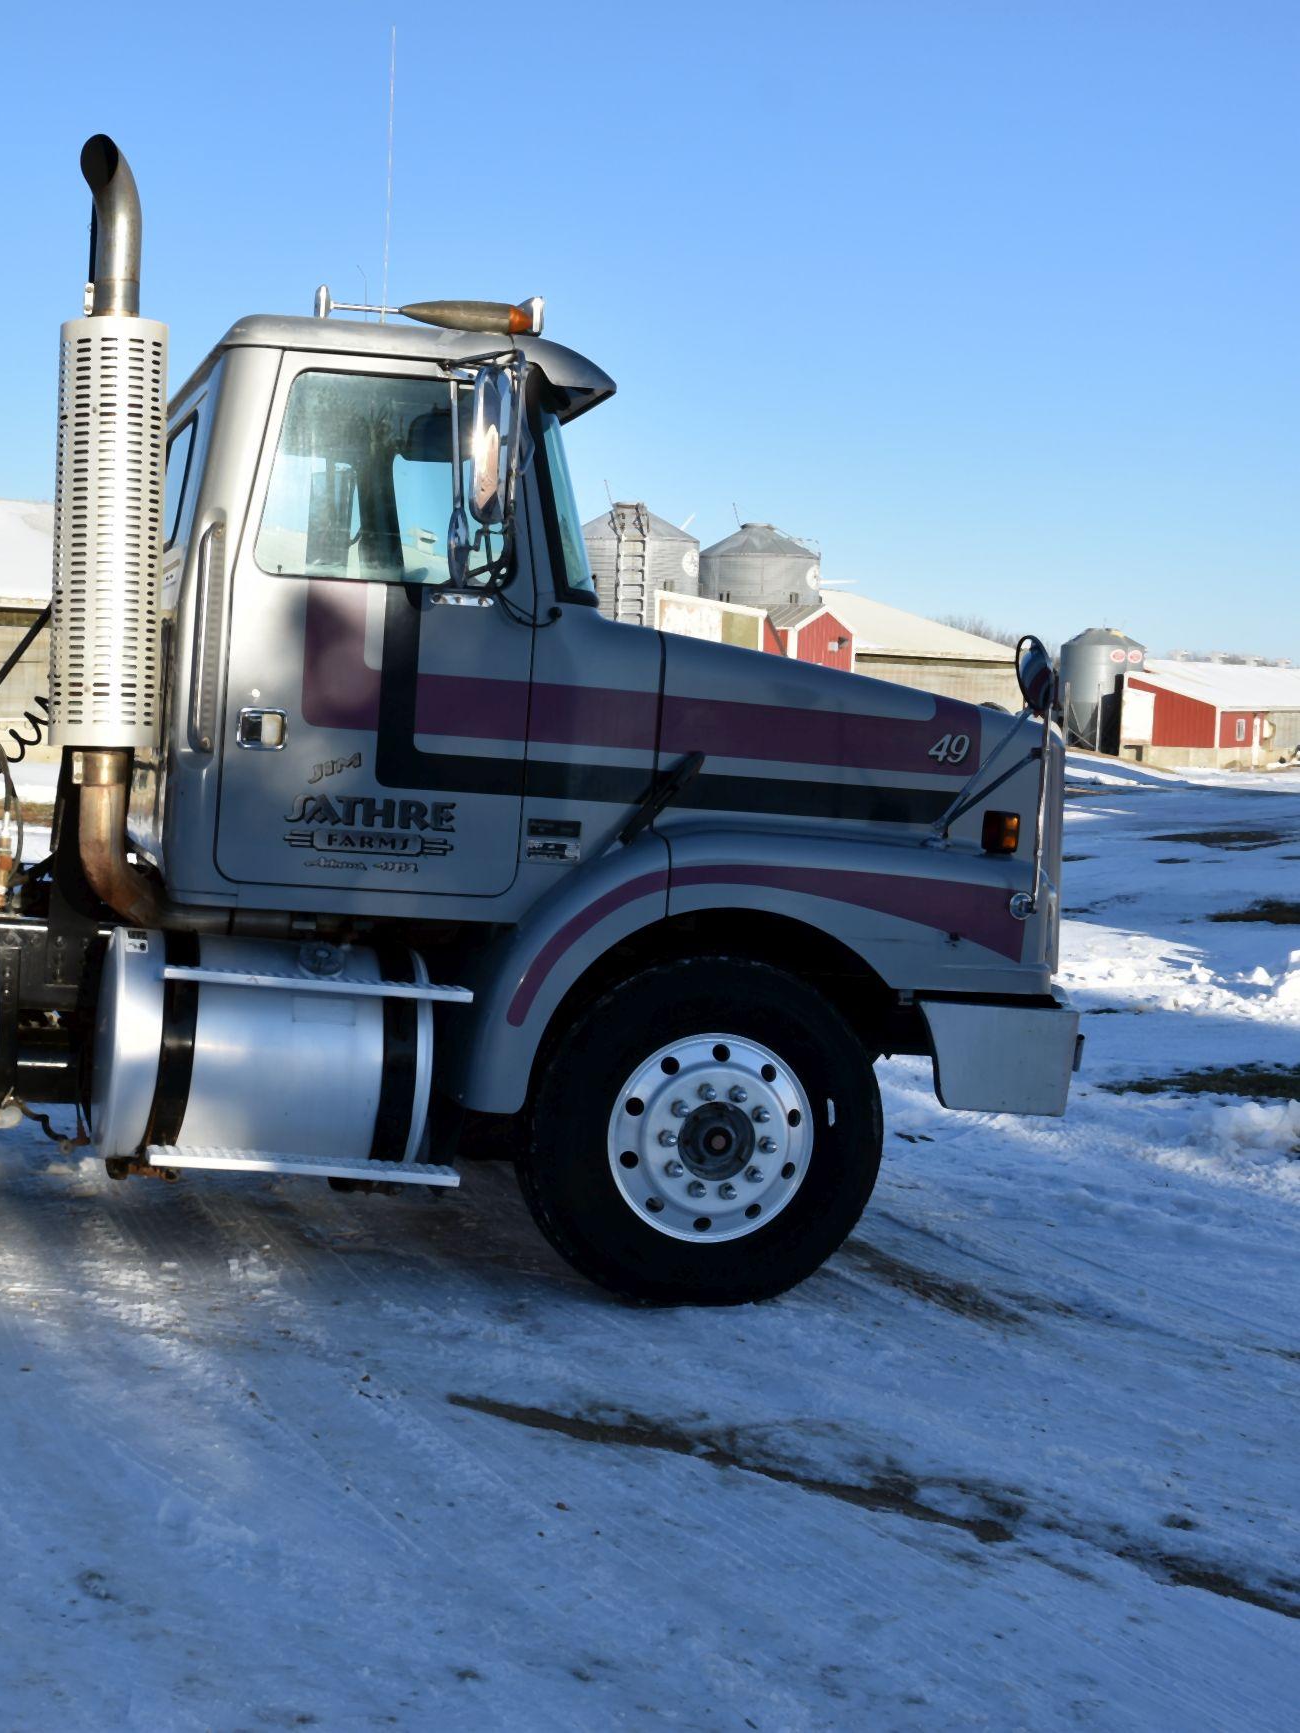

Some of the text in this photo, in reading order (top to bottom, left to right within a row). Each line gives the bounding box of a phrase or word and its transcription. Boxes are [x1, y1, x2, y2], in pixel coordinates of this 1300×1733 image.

[927, 733, 970, 764] 49
[308, 752, 362, 785] JIM
[284, 793, 457, 833] SATHRE
[326, 833, 410, 851] FARMS
